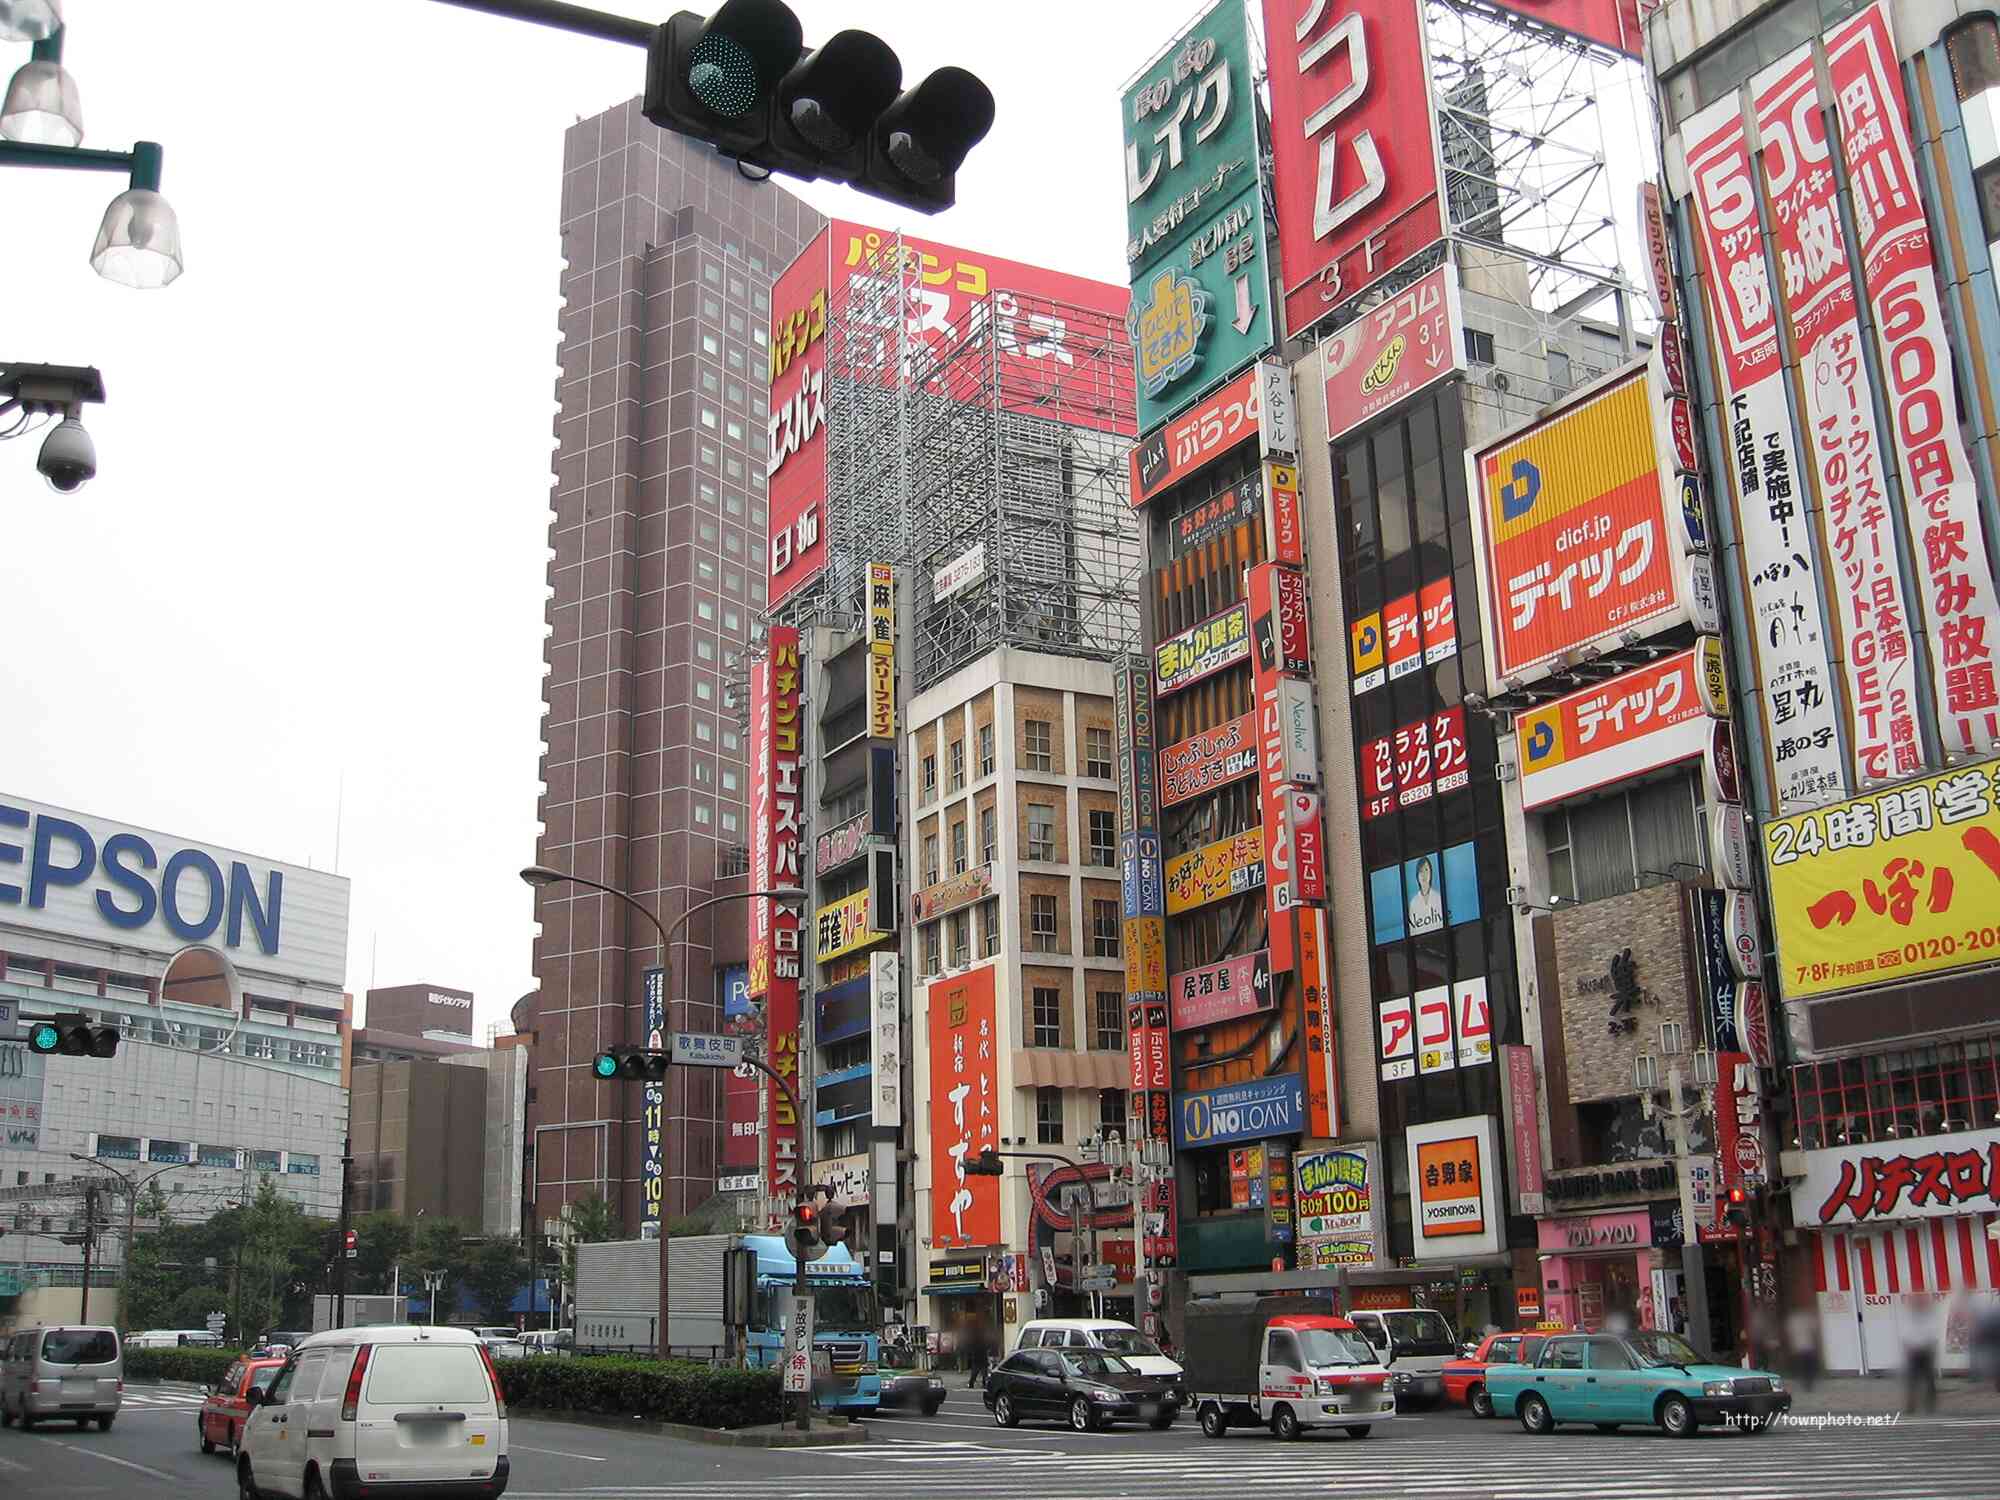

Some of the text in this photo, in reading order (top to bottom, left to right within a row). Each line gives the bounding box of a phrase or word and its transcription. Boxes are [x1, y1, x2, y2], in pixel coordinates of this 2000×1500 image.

[1126, 58, 1231, 205] レイク
[844, 231, 988, 297] パチンコ
[1319, 240, 1387, 302] 3F
[769, 287, 827, 385] パチンコ
[1375, 284, 1441, 342] アコム
[1419, 313, 1445, 346] 3F
[768, 367, 826, 477] エスパス
[1268, 374, 1286, 443] 戸谷ビル
[1278, 493, 1293, 545] ディック
[1554, 513, 1612, 552] dicf.jp
[1507, 518, 1655, 632] ディック
[873, 584, 891, 641] 麻雀
[1386, 593, 1454, 649] ディック
[1157, 610, 1246, 680] まんが喫茶
[1287, 660, 1305, 670] 5F
[776, 642, 798, 751] パチンコ
[1135, 672, 1150, 748] PRONTO
[1576, 669, 1682, 745] ディック
[1165, 725, 1241, 775] しゃぶしゃぶ
[1243, 749, 1257, 769] 4F
[1375, 716, 1449, 764] カラオケ
[1375, 736, 1467, 793] ビックワン
[1775, 727, 1835, 763] 虎の子
[1167, 758, 1225, 801] うどんすき
[1370, 776, 1391, 816] 5F
[1249, 864, 1263, 885] 7F
[1299, 831, 1317, 881] アコム
[817, 907, 841, 956] 麻雀
[1184, 967, 1232, 1002] 居酒屋
[1253, 967, 1269, 990] 4F
[1305, 985, 1322, 1054] 吉野家
[1382, 993, 1490, 1059] アコム
[1392, 1062, 1408, 1078] 3F
[1424, 1159, 1474, 1189] 吉野家
[1427, 1203, 1477, 1219] YOSHINOYA
[1604, 1221, 1637, 1244] YOU
